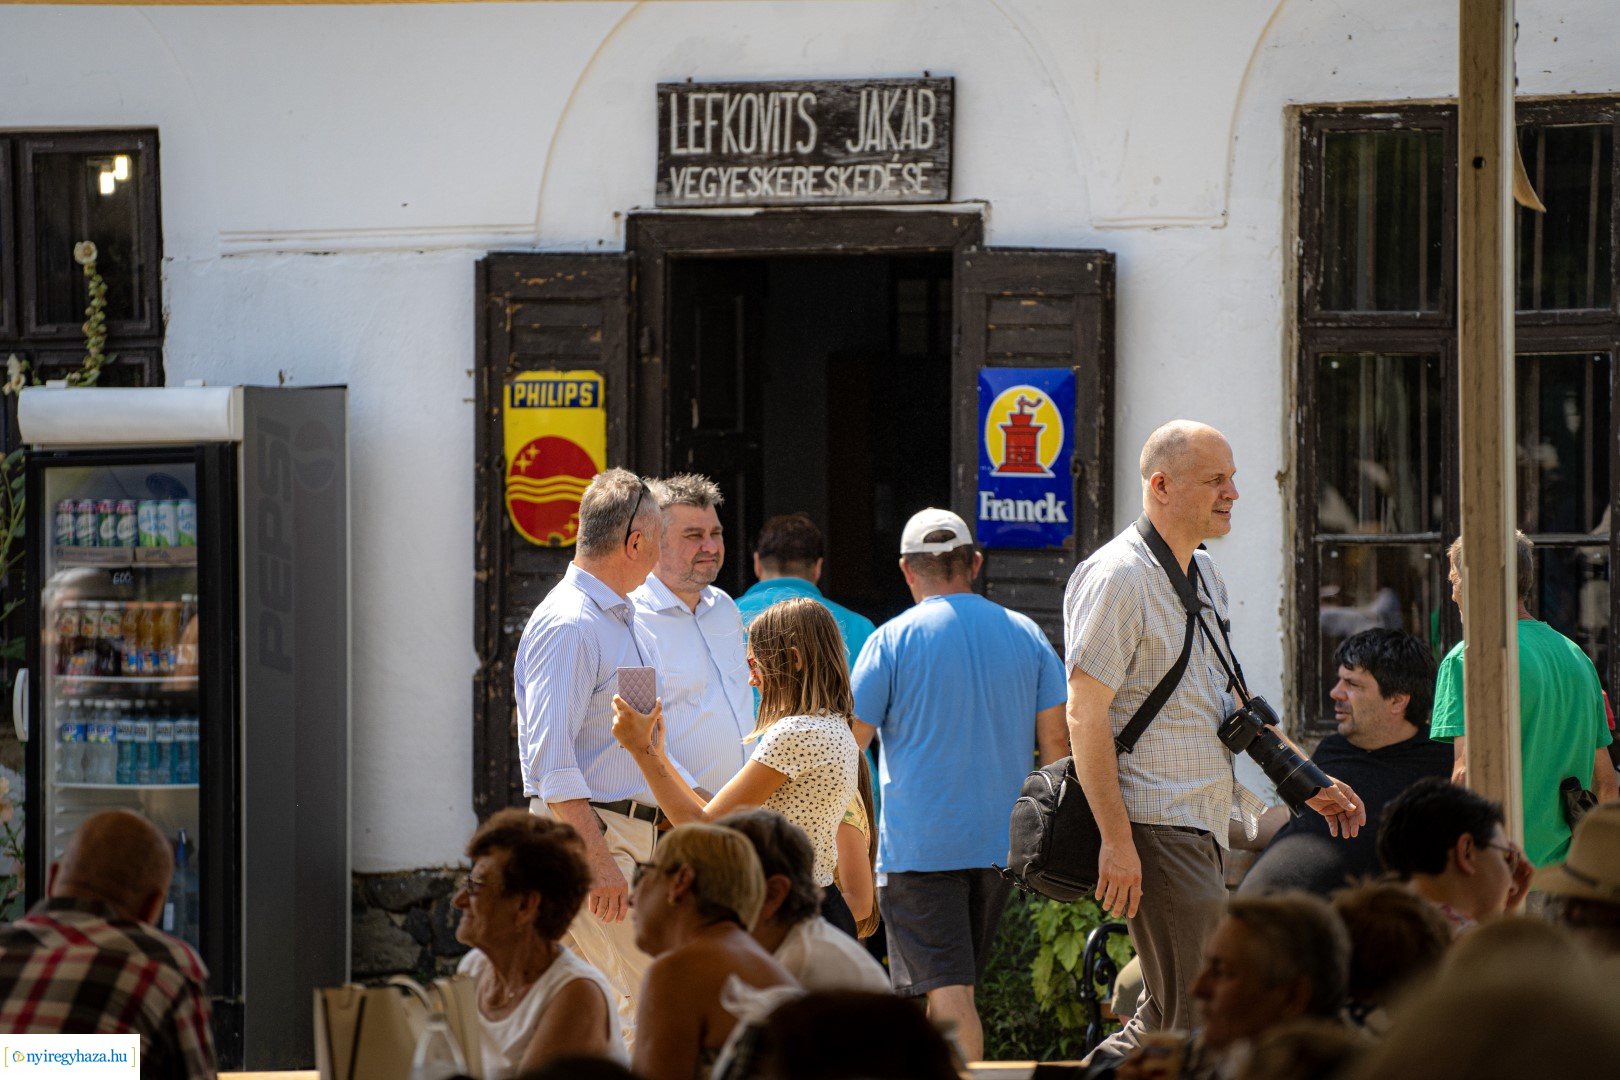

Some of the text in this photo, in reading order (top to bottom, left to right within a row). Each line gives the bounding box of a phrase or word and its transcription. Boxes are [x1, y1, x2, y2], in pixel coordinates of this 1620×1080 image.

[669, 88, 936, 154] LEFKOVITS JAKAB
[669, 154, 934, 198] VEGYESKERESKEDÉSE
[513, 382, 594, 408] PHILIPS
[978, 491, 1069, 523] Franck
[256, 416, 293, 674] PEPSI
